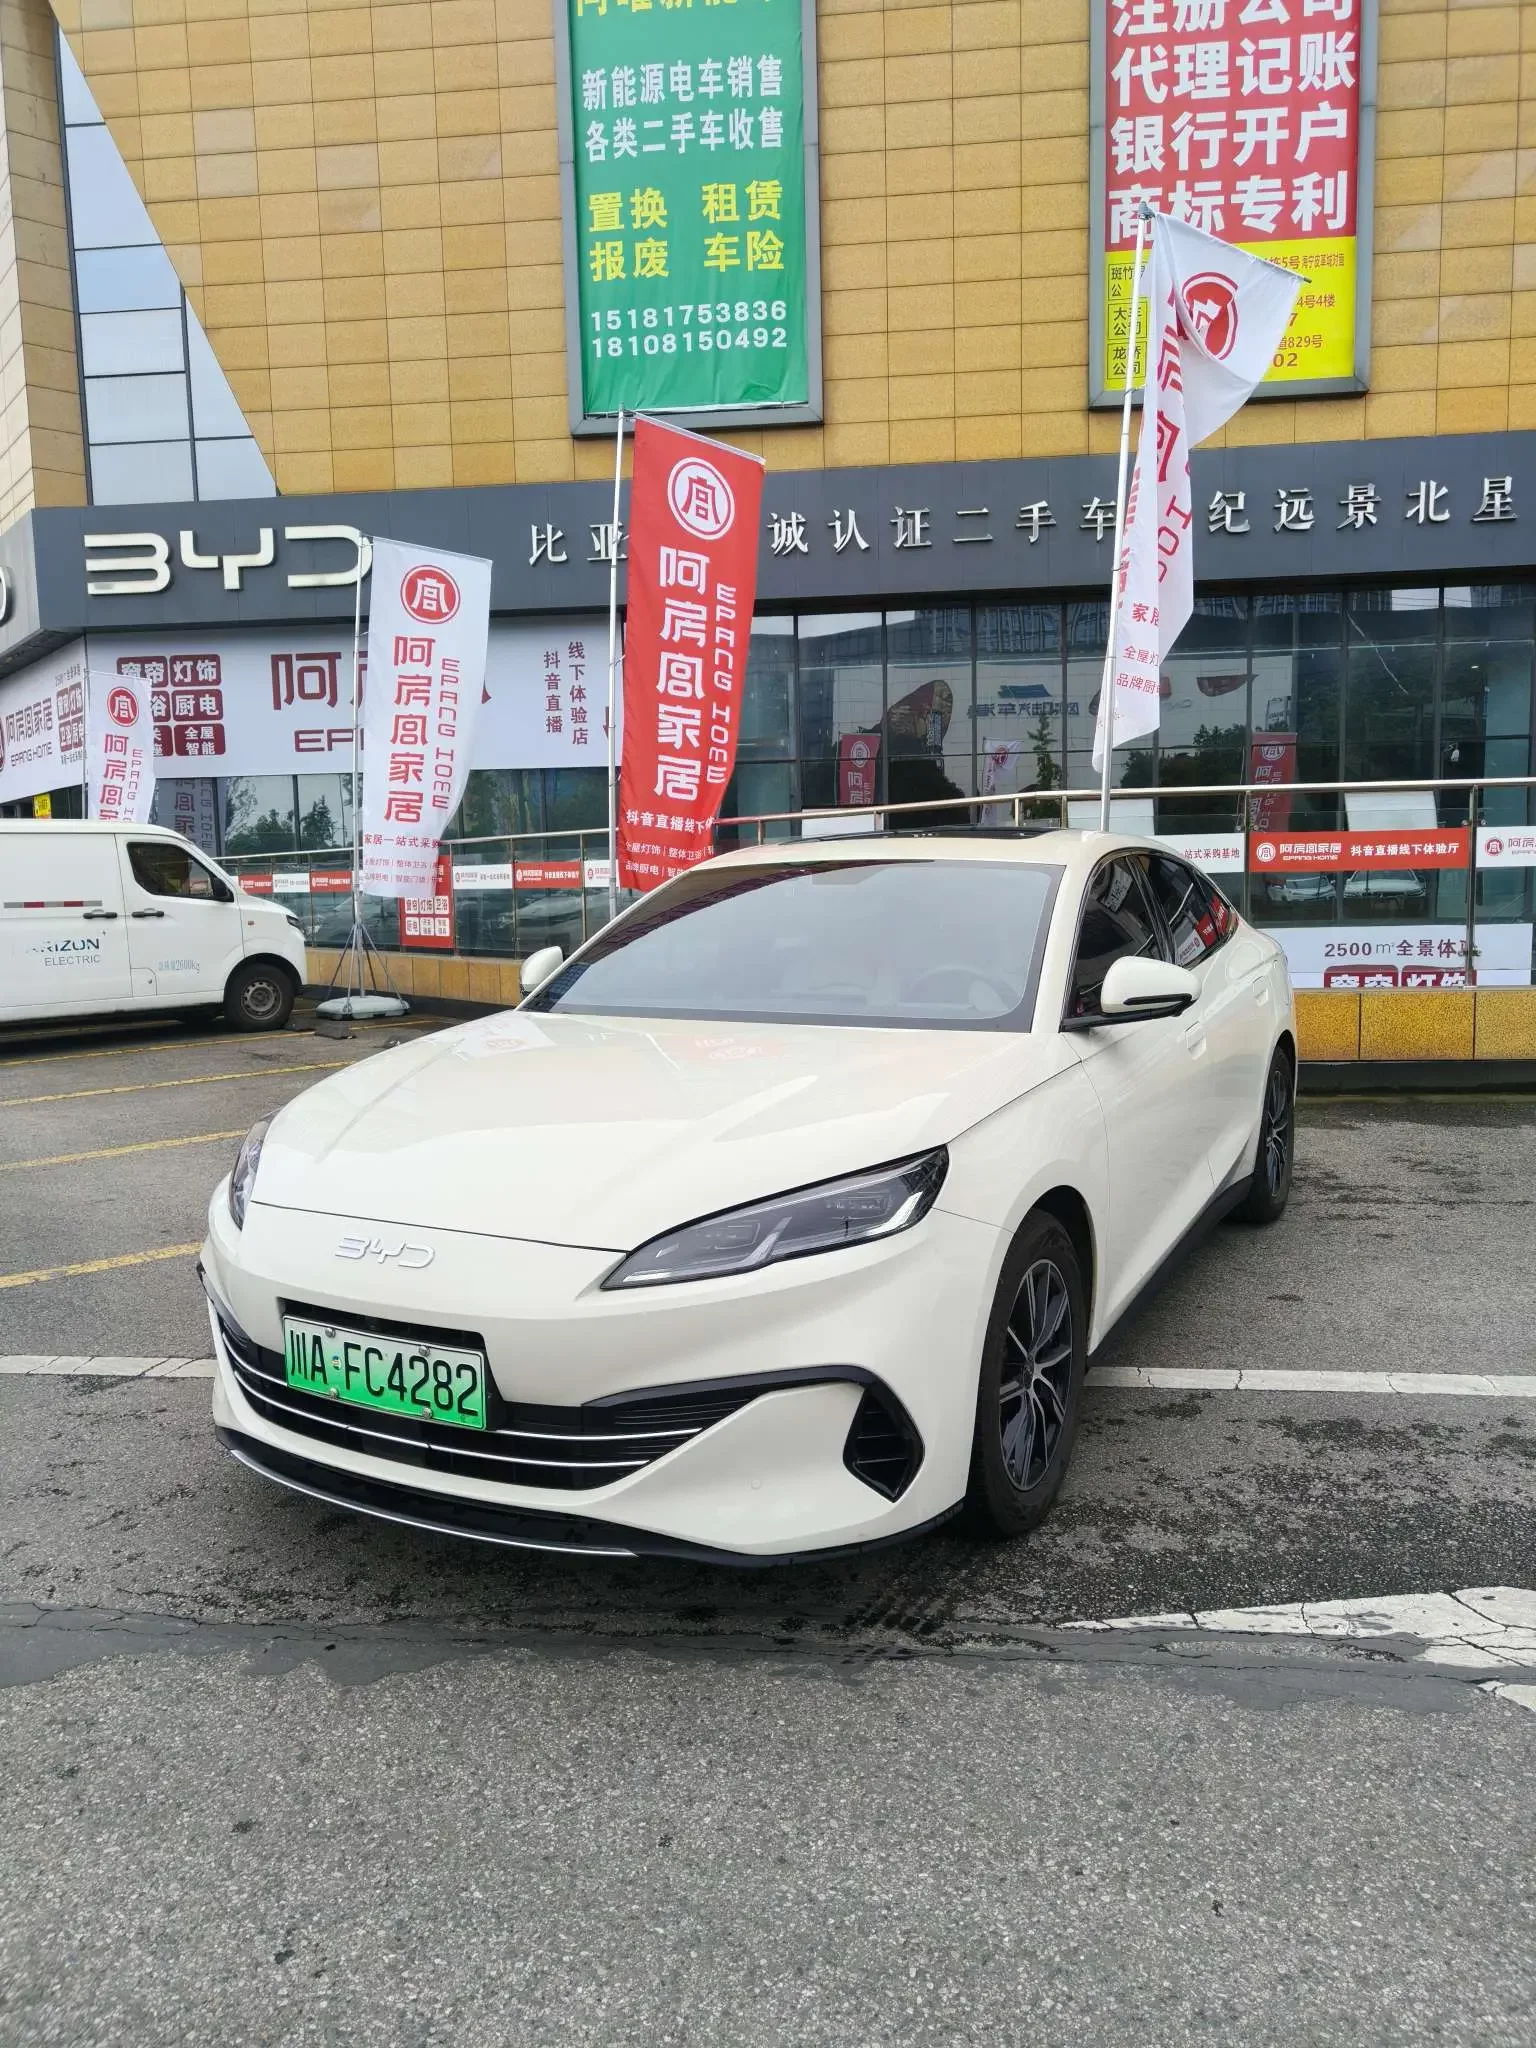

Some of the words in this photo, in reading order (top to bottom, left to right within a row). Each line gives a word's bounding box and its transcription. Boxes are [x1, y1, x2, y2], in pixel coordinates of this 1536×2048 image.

[583, 55, 783, 111] 新能源电车销售
[1111, 31, 1356, 106] 代理记账
[585, 106, 784, 163] 各类二手车收售
[1110, 101, 1348, 176] 银行开户
[588, 188, 668, 233] 置换
[702, 180, 783, 224] 租赁
[1108, 170, 1347, 244] 商标专利
[590, 239, 669, 282] 报废
[704, 230, 784, 272] 车险
[591, 300, 787, 332] 15181753836
[592, 328, 788, 358] 18108150492
[84, 523, 374, 596] BYD
[173, 660, 217, 682] 灯饰
[544, 651, 562, 733] 抖音直播
[568, 641, 588, 745] 线下体验店
[653, 546, 710, 802] 阿房宫家居
[176, 693, 219, 717] 厨电
[384, 635, 436, 824] 阿房宫家居
[184, 726, 215, 740] 全屋
[185, 742, 215, 755] 智能
[1279, 842, 1342, 854] 阿房宫家居
[1350, 842, 1460, 857] 抖音直播线下体验厅
[44, 955, 101, 967] ELECTRIC
[335, 1236, 436, 1269] BYD
